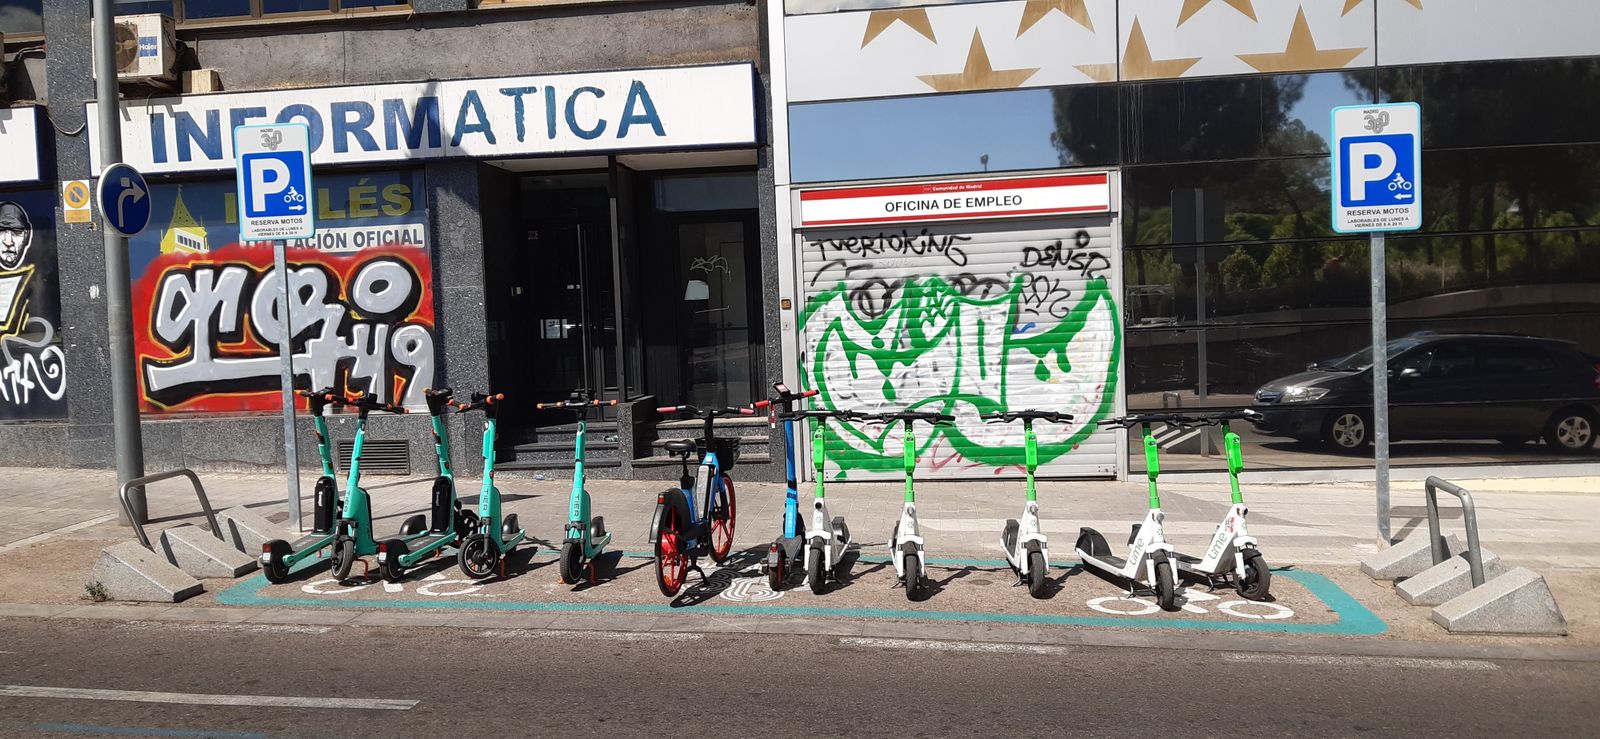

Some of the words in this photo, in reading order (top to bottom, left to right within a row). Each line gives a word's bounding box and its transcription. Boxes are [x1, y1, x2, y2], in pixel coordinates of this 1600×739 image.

[250, 158, 290, 212] P
[1349, 142, 1397, 201] P
[224, 177, 412, 224] ILÉS
[885, 200, 939, 213] OFICINA
[943, 199, 962, 210] DE
[966, 195, 1022, 208] EMPLEO
[353, 229, 423, 248] OFICIAL
